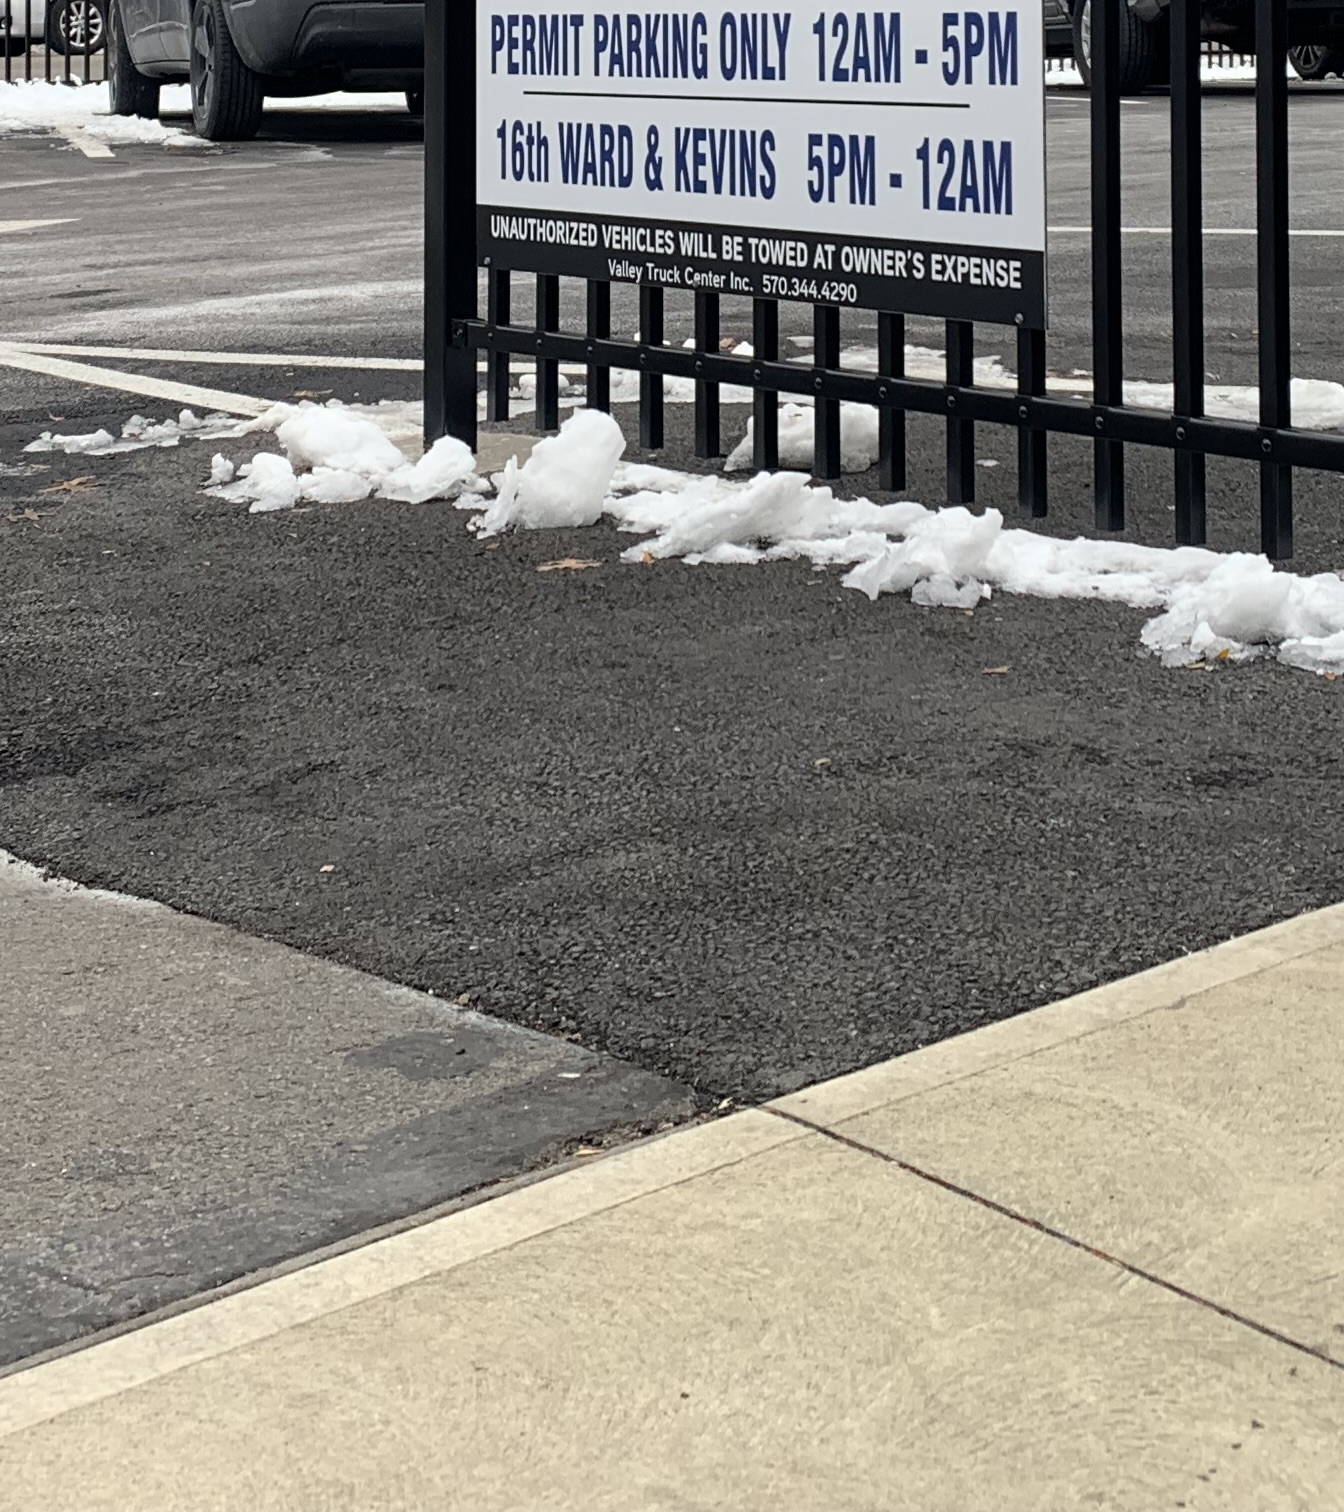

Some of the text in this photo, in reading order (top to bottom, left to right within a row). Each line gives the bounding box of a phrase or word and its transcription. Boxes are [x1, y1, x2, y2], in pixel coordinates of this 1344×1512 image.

[491, 11, 1018, 86] PERMIT PARKING ONLY 12AM - 5PM
[496, 118, 1013, 216] 16th WARD & KEVINS 5PM - 12AM
[490, 214, 1023, 289] UNAUTHORIZED VEHICLES WILL BE TOWED AT OWNER'S EXPENSE
[607, 258, 858, 304] Valley Truck Center Inc. 570.344.4290
